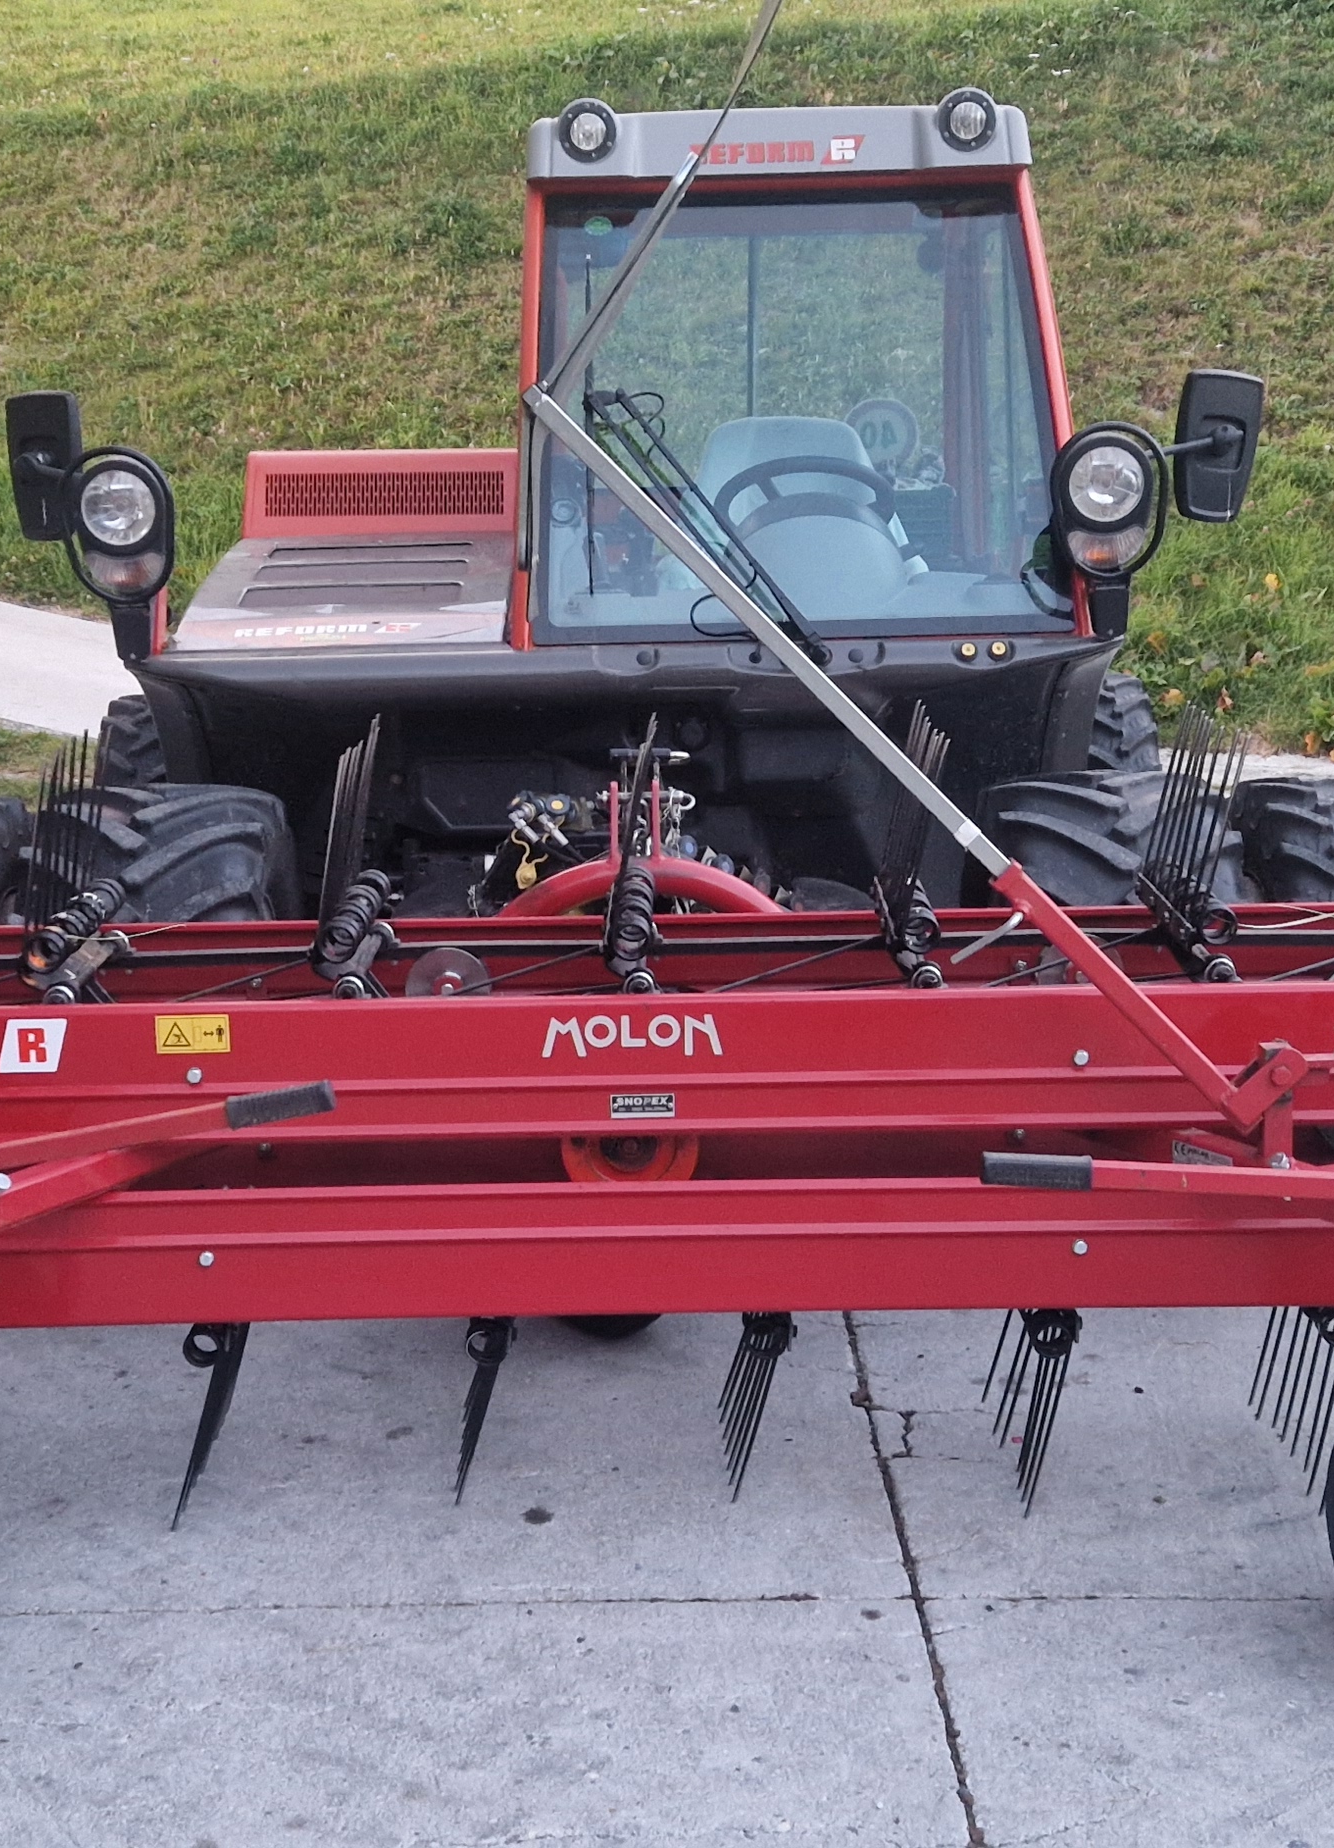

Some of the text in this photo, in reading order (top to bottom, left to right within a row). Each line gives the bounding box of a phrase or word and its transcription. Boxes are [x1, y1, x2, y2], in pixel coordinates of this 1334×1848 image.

[831, 138, 856, 161] R
[234, 624, 367, 638] REFORM
[18, 1028, 47, 1063] R
[542, 1014, 723, 1058] MOLON
[616, 1096, 669, 1107] SNOPEX
